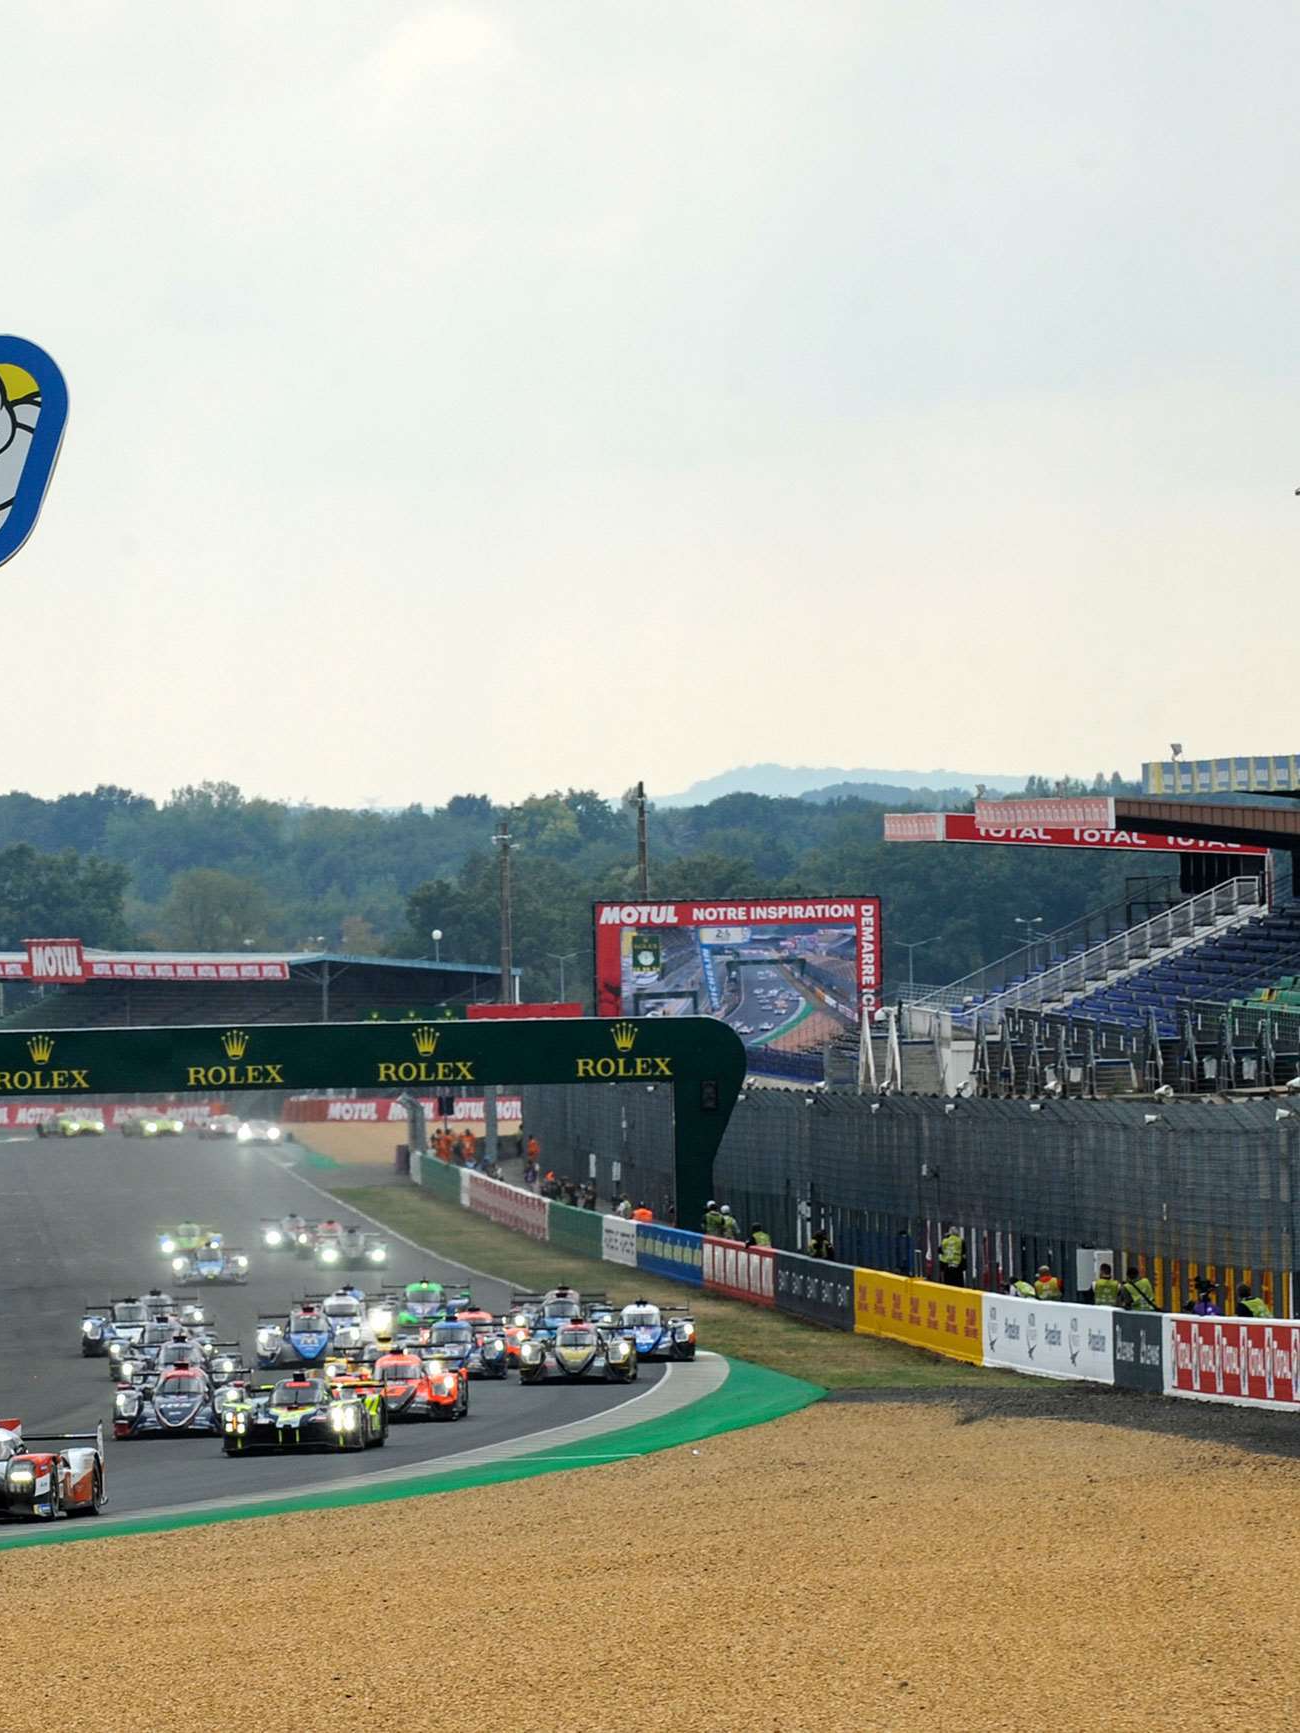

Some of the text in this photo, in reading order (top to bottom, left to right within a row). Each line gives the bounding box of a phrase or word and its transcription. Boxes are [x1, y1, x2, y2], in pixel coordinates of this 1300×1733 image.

[1073, 828, 1147, 844] TOTAL
[599, 905, 678, 924] MOTUL
[692, 903, 856, 922] NOTRE INSPIRATION
[860, 904, 876, 985] DEMARRE
[31, 945, 82, 976] MOTUL
[187, 1064, 283, 1086] ROLEX
[378, 1061, 474, 1081] ROLEX
[576, 1057, 673, 1077] ROLEX
[327, 1102, 378, 1120] MOTUL
